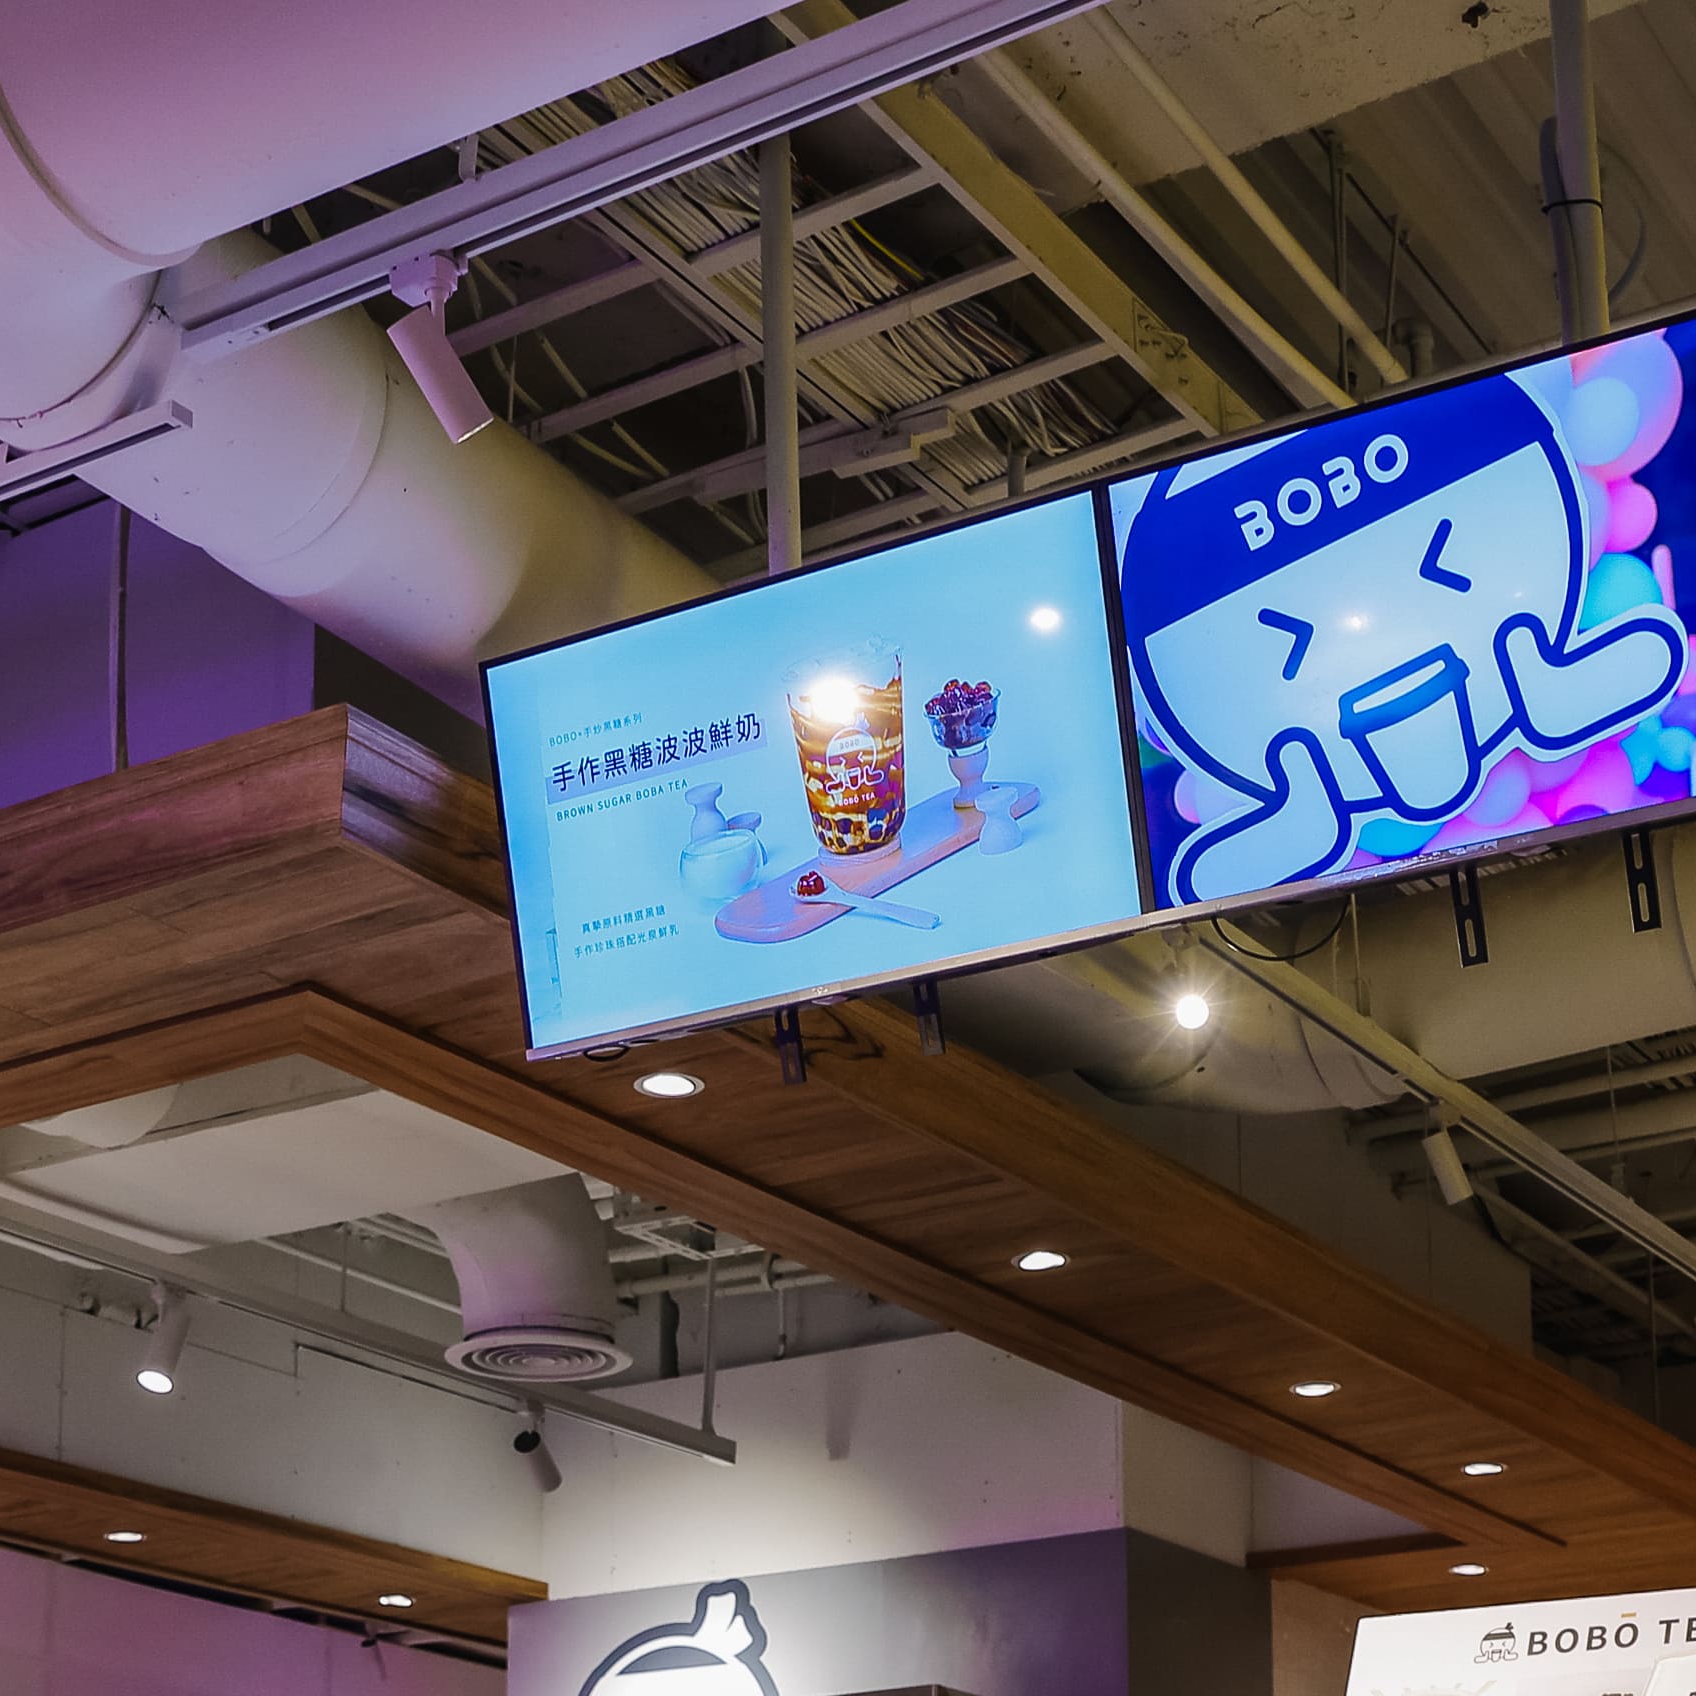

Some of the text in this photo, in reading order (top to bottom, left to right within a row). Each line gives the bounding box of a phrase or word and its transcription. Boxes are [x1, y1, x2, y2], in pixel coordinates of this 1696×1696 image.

[1233, 432, 1410, 553] BOBO
[551, 713, 761, 791] 手作黑糖波波鮮奶
[557, 779, 689, 821] BROWN SUGAR BOBA TEA
